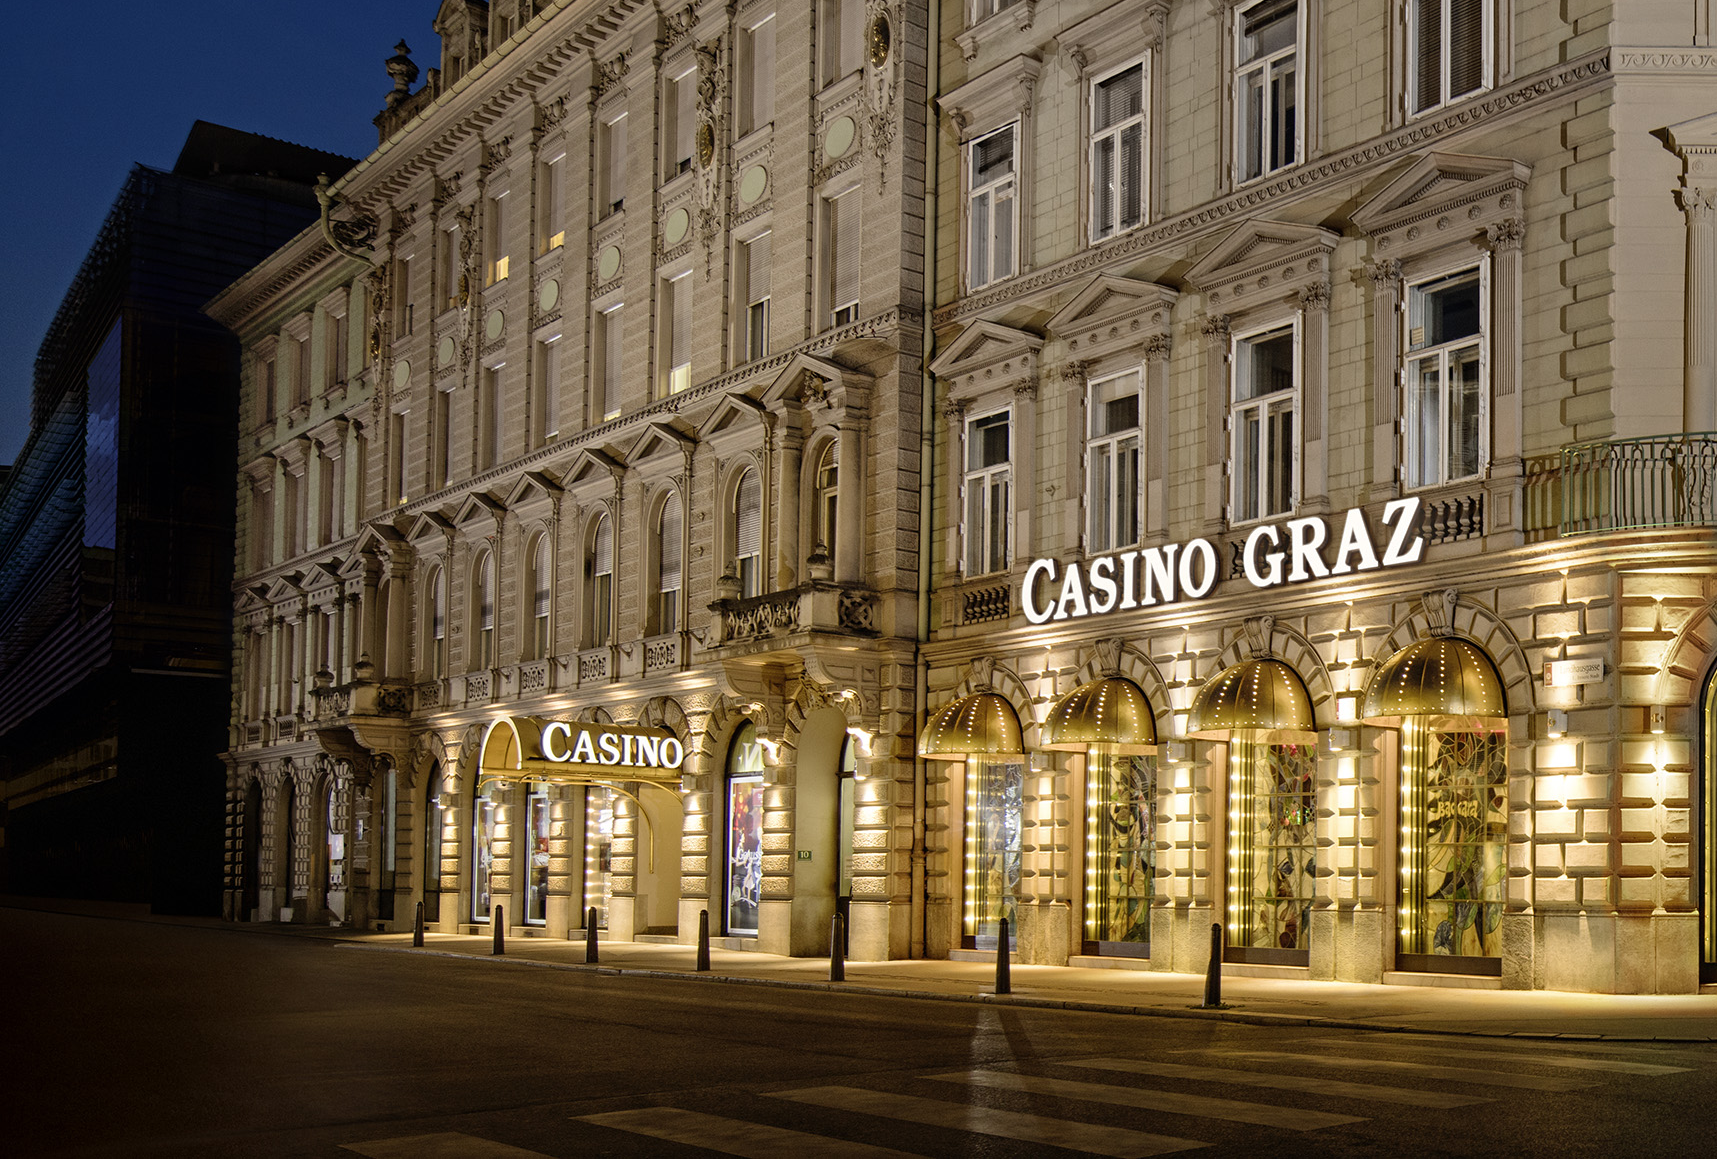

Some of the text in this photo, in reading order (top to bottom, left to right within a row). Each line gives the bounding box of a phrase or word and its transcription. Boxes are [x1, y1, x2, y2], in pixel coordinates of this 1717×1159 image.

[1022, 496, 1424, 624] CASINO GRAZ
[541, 721, 684, 769] CASINO
[800, 851, 809, 859] 10
